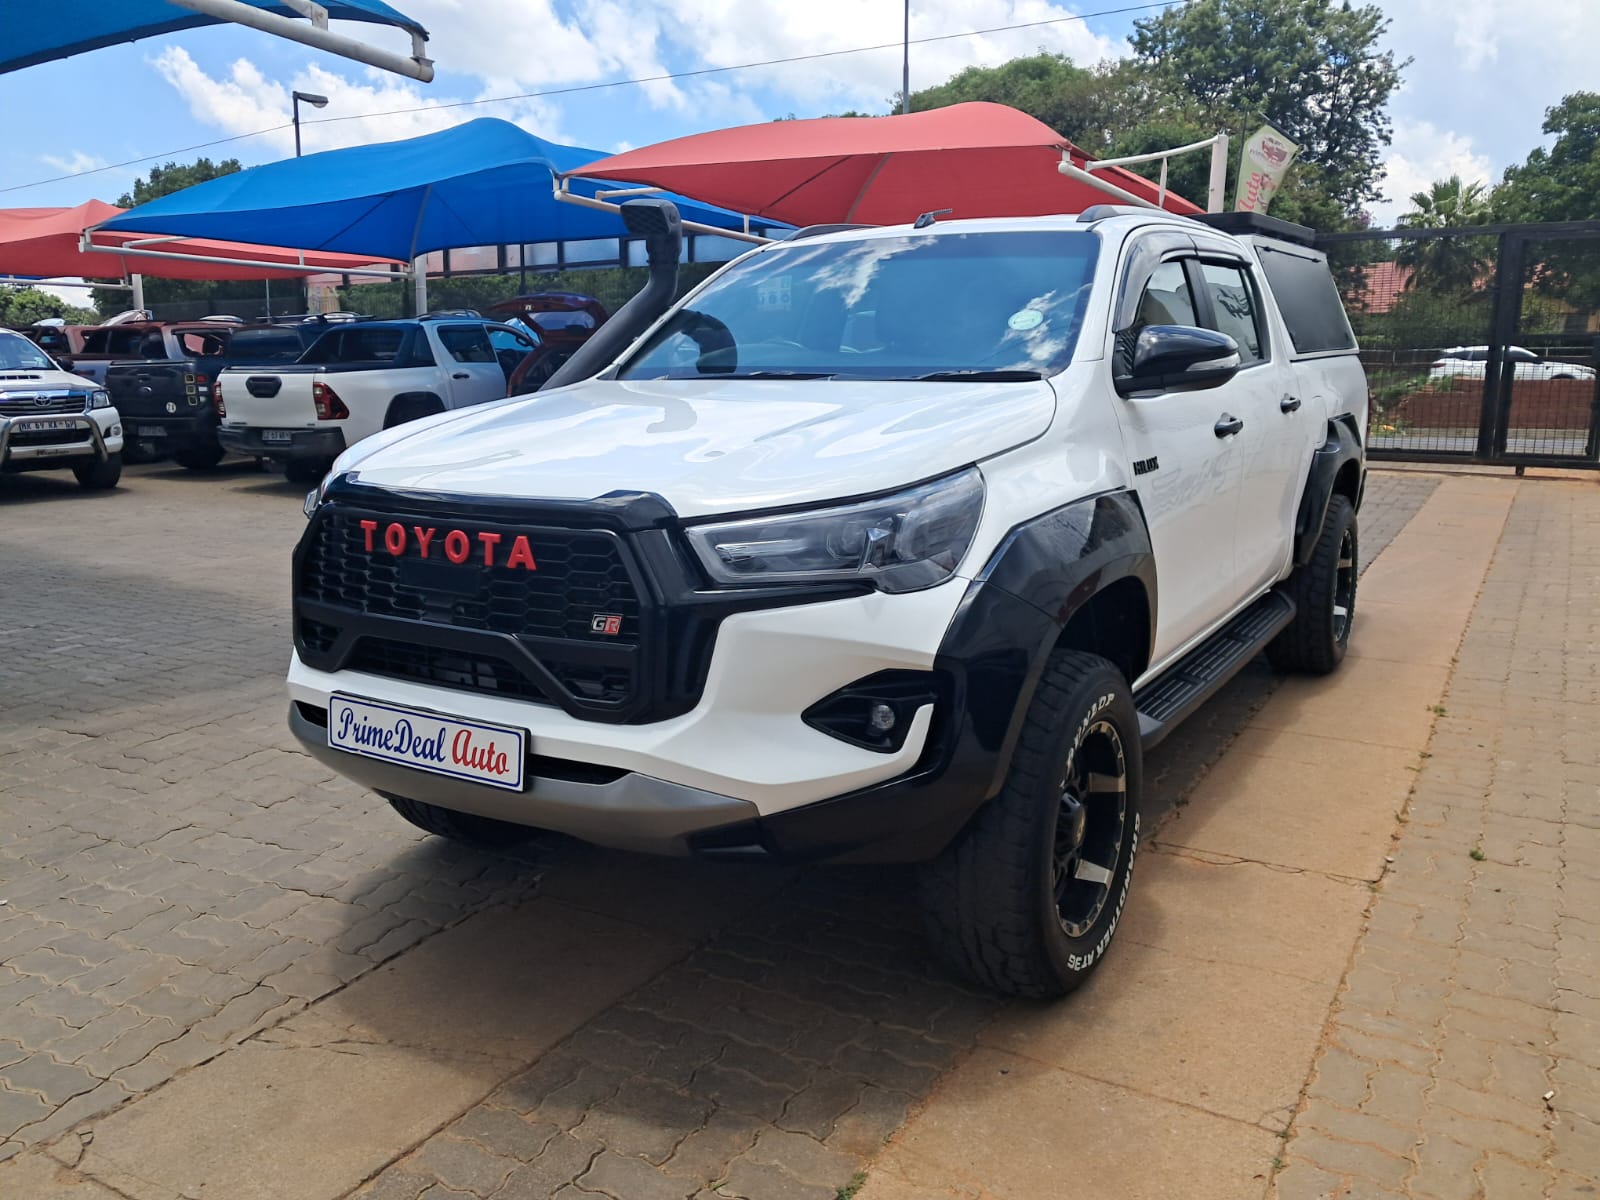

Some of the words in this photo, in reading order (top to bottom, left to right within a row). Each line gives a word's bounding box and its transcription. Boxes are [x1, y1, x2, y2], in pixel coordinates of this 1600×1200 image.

[1133, 456, 1159, 476] HILUX
[360, 520, 537, 571] TOYOTA
[592, 616, 620, 632] GR
[337, 707, 446, 763] PrimeDeal
[452, 729, 510, 775] Auto
